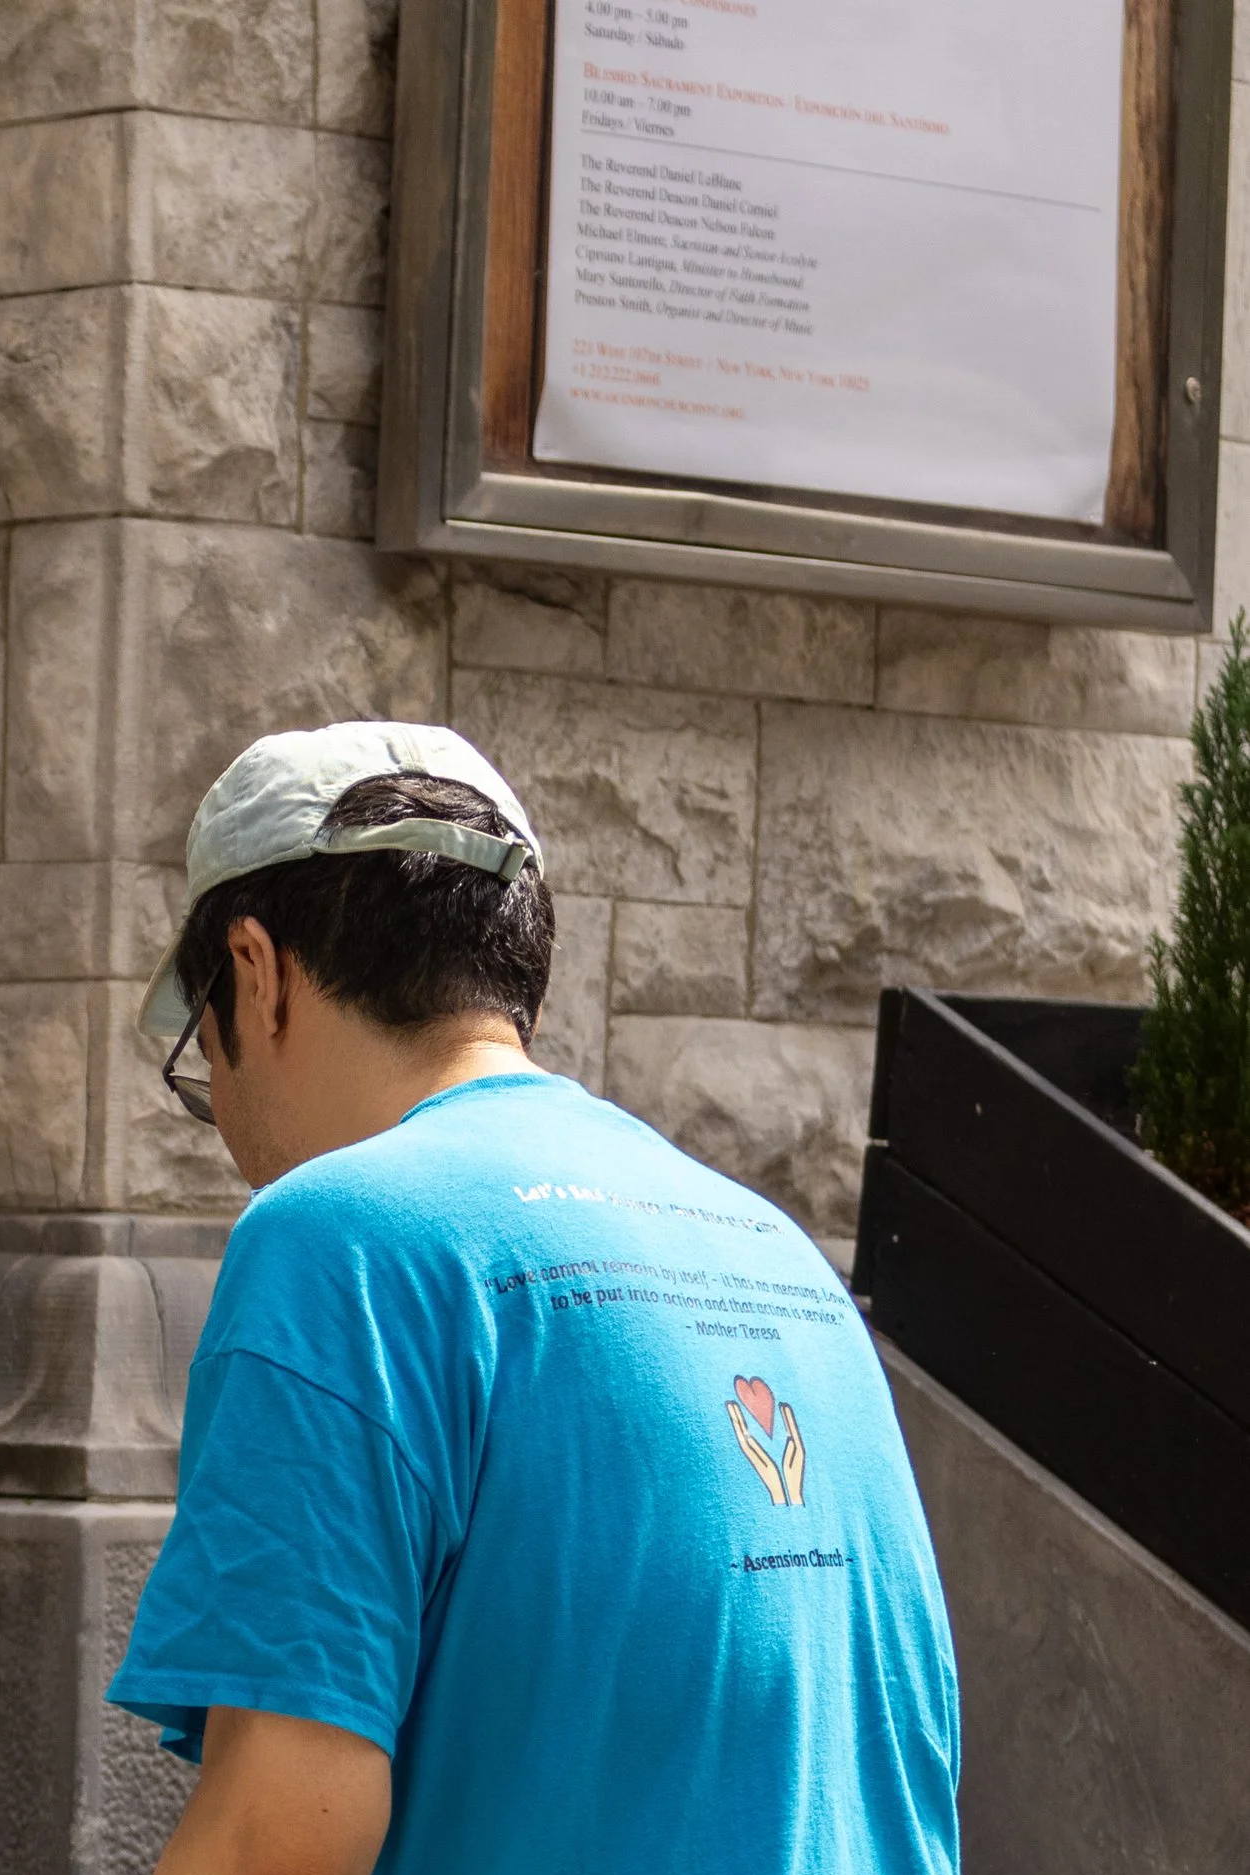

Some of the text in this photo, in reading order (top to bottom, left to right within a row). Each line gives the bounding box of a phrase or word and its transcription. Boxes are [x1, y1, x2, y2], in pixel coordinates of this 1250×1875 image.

[583, 23, 635, 45] Saturday
[581, 110, 623, 131] Fridays
[580, 153, 602, 171] The
[605, 158, 657, 179] Reverend
[659, 164, 695, 185] Daniel
[579, 176, 601, 193] The
[604, 180, 655, 201] Reverend
[659, 187, 699, 207] Deacon
[701, 194, 736, 213] Daniel
[577, 199, 600, 216] The
[603, 202, 654, 223] Reverend
[658, 209, 697, 229] Deacon
[700, 216, 737, 235] Nelson
[577, 222, 622, 242] Michael
[575, 244, 625, 265] Cipriano
[575, 267, 604, 287] Mary
[669, 279, 712, 299] Director
[574, 289, 616, 308] Preston
[540, 1259, 600, 1283] cannot
[601, 1260, 659, 1279] remain
[660, 1264, 676, 1286] by
[720, 1272, 731, 1289] it
[732, 1273, 754, 1291] has
[755, 1280, 770, 1294] no
[550, 1294, 569, 1311] to
[572, 1288, 593, 1306] be
[595, 1286, 625, 1308] put
[626, 1285, 659, 1303] into
[662, 1291, 703, 1311] action
[705, 1296, 729, 1313] and
[730, 1296, 754, 1315] that
[756, 1301, 789, 1320] action
[791, 1304, 801, 1320] is
[694, 1319, 738, 1339] Mother
[739, 1323, 783, 1341] Teresa
[743, 1548, 809, 1573] Ascension
[809, 1547, 845, 1568] Church
